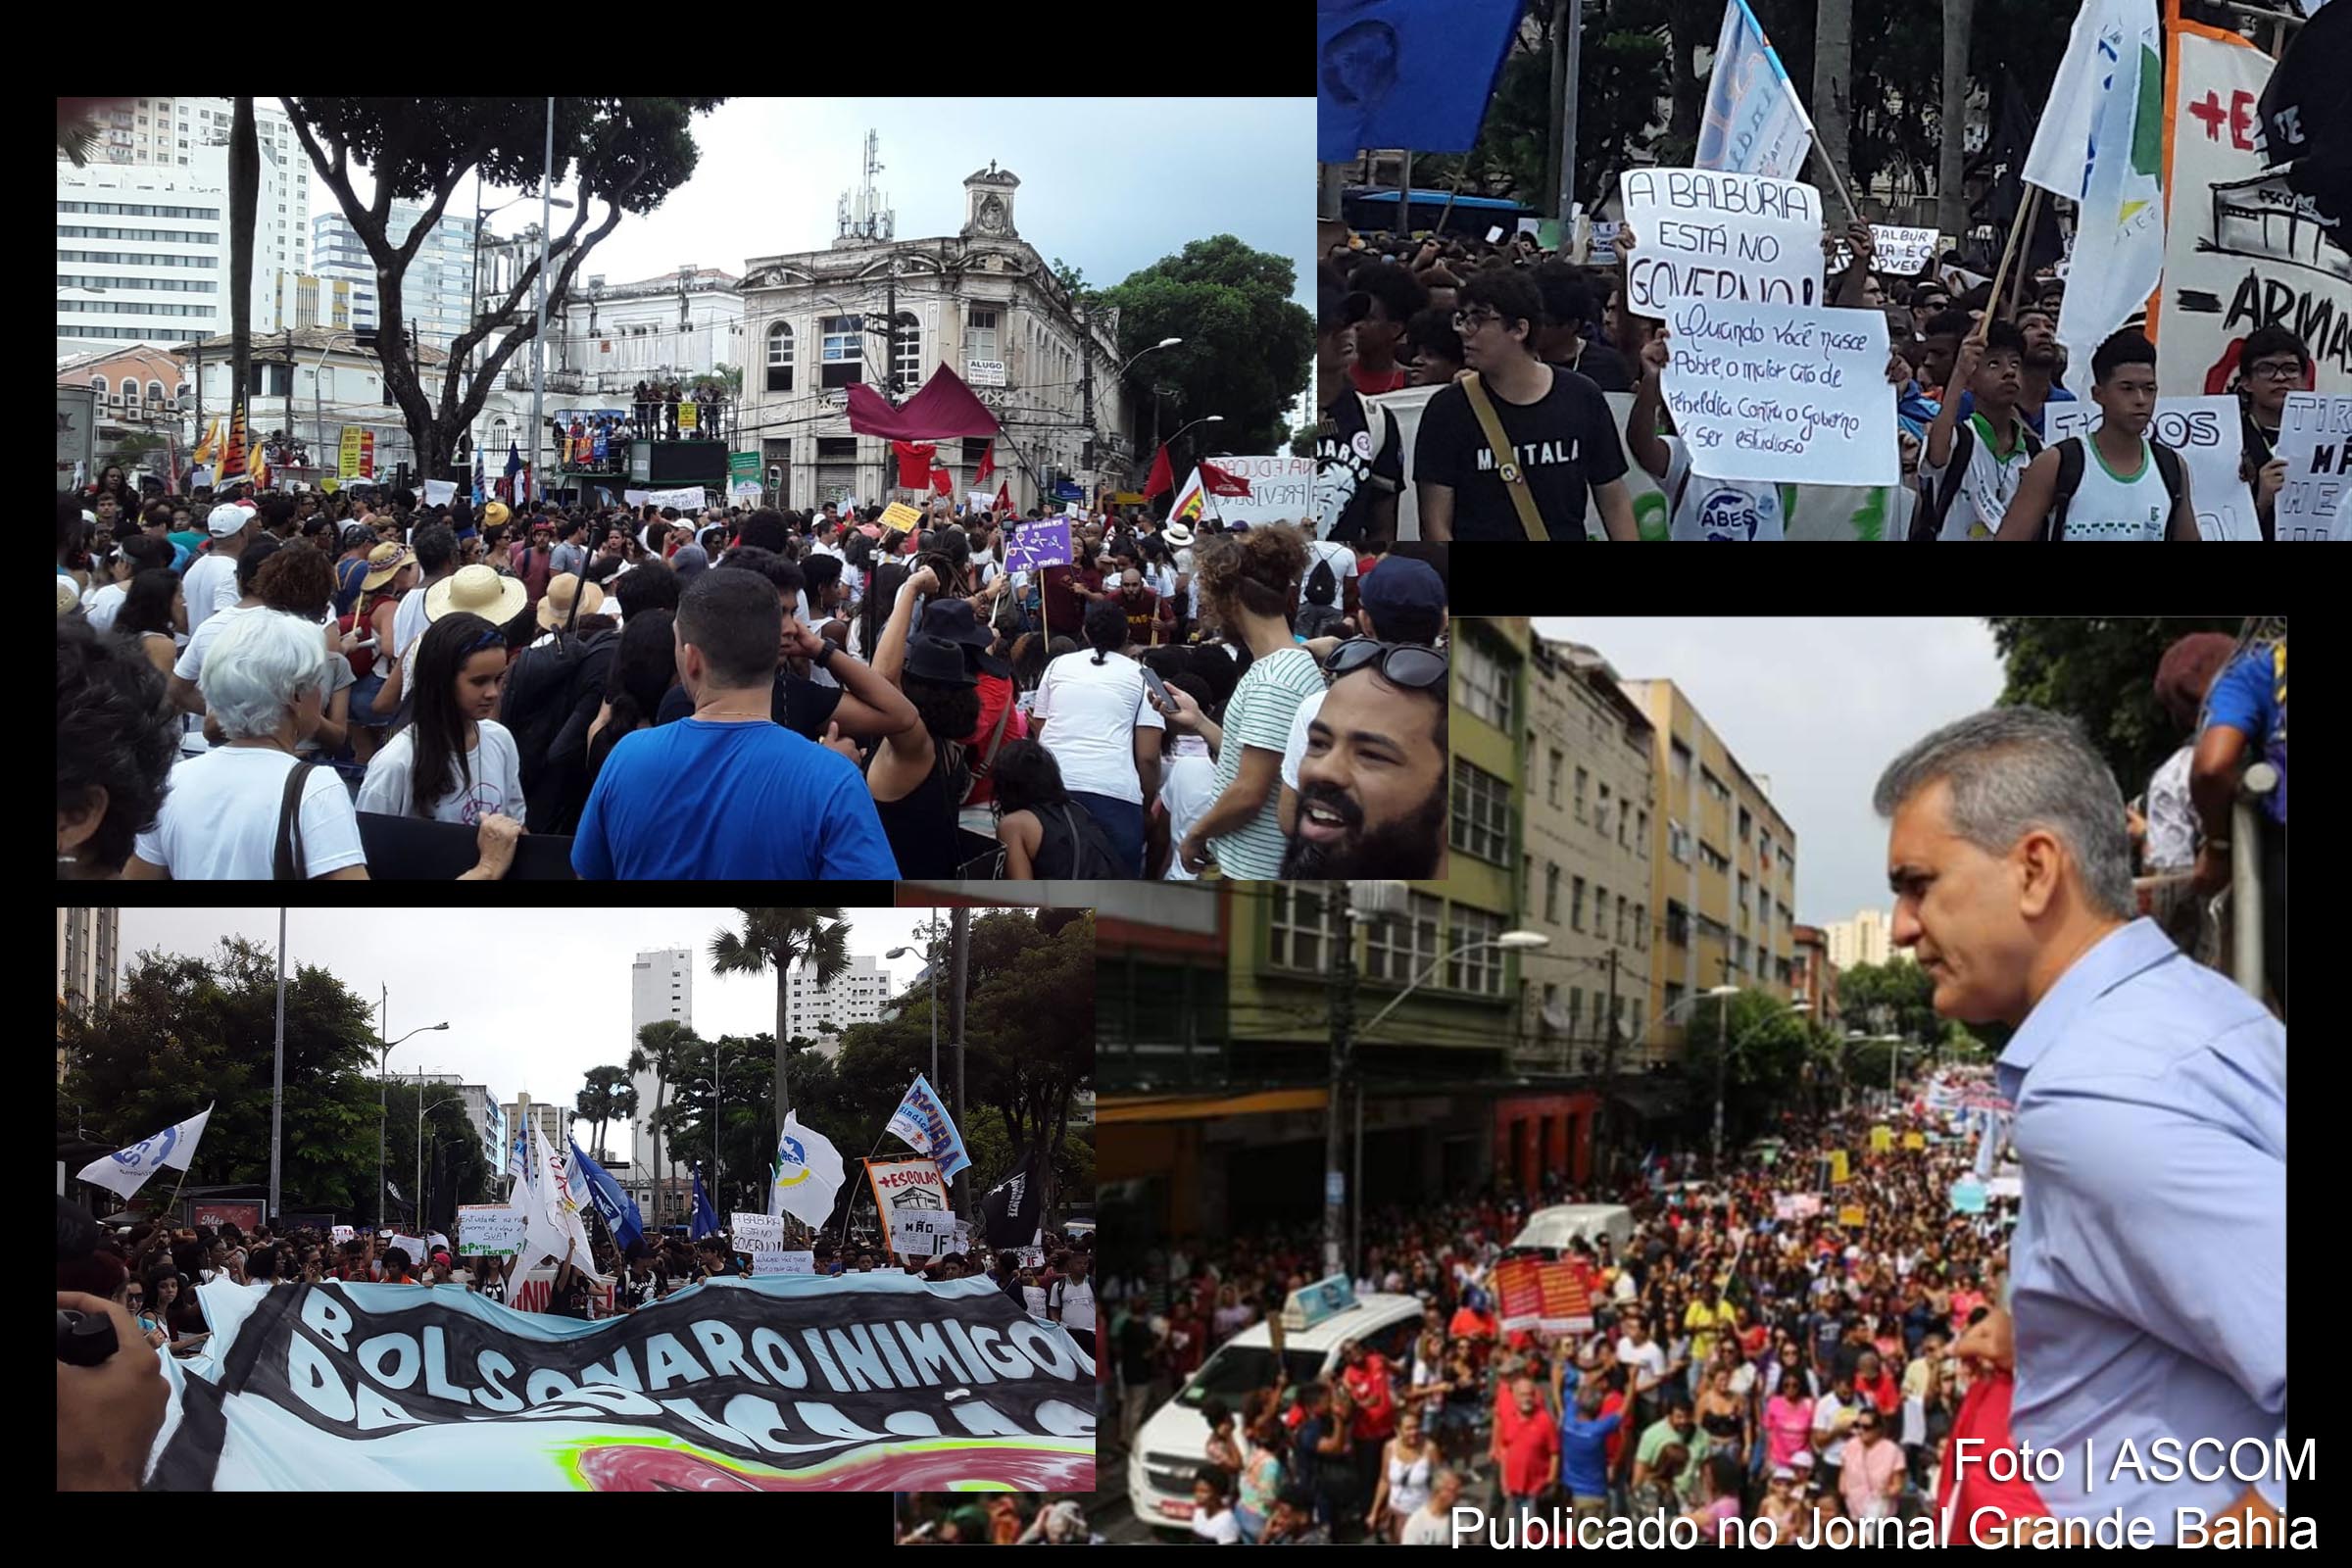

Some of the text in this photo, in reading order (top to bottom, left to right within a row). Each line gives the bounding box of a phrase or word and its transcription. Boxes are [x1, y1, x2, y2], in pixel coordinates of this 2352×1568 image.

[1628, 172, 1808, 221] A BALBÚRIA
[1659, 220, 1780, 263] ESTÁ NO
[1675, 303, 1764, 353] Quando
[1822, 329, 1868, 361] nasce
[2223, 267, 2352, 373] ARMA
[970, 361, 1003, 369] ALUGO
[1820, 363, 1842, 387] de
[1786, 408, 1798, 422] o
[1701, 509, 1758, 527] ABES
[933, 1235, 950, 1255] IF
[301, 1287, 1077, 1412] BOLSONARO INIMIGO
